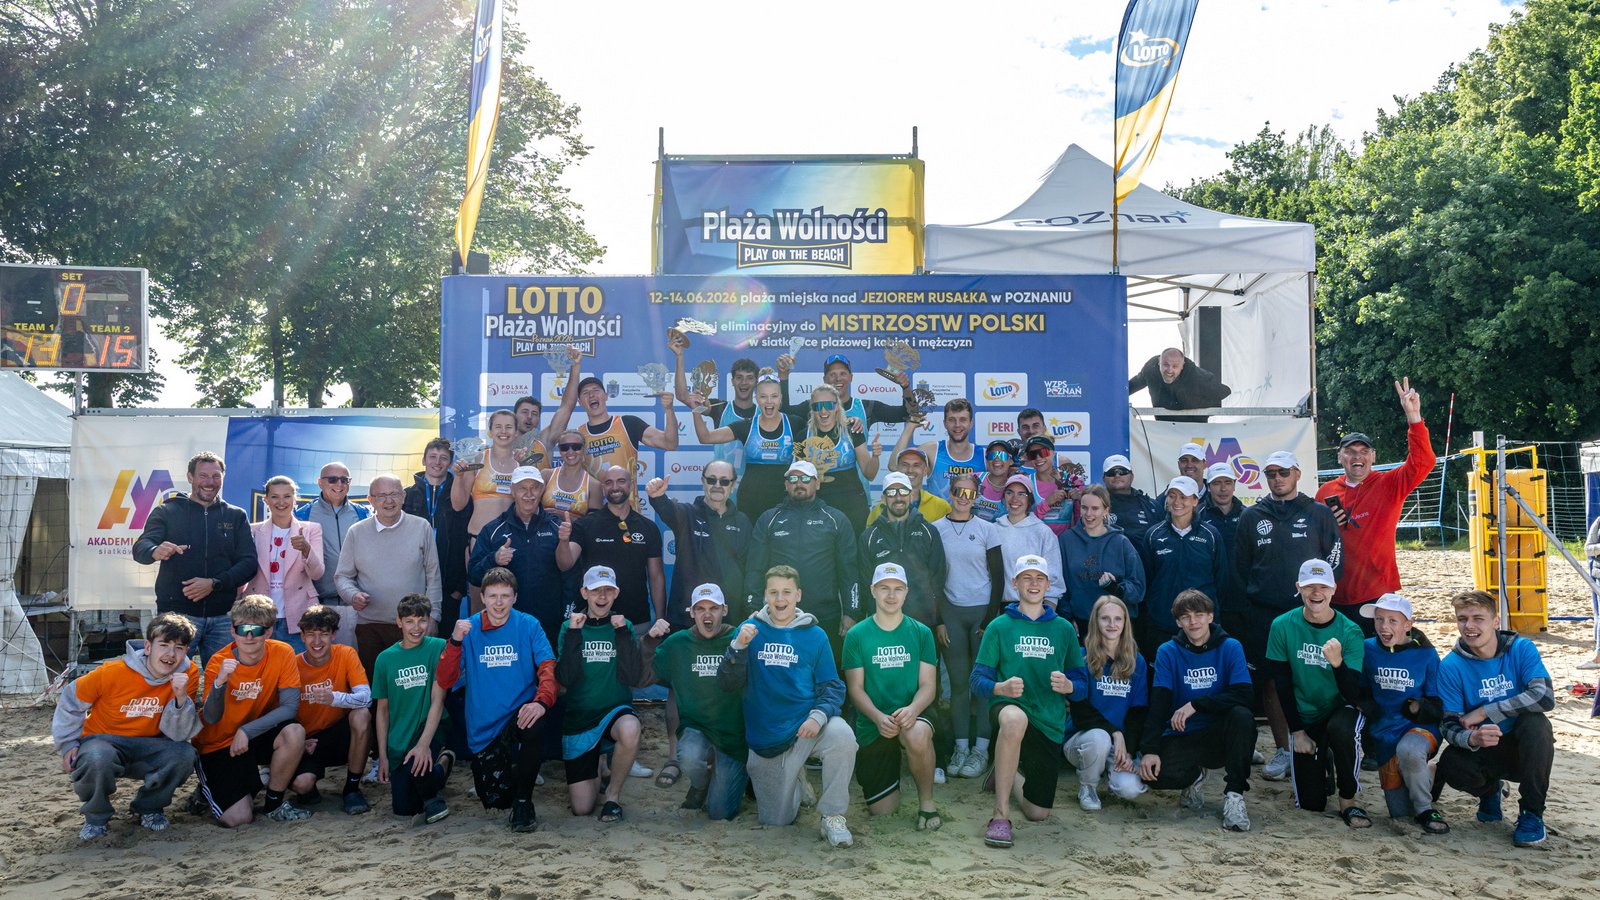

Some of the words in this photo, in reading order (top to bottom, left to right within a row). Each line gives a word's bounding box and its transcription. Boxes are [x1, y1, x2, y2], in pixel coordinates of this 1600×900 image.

[1133, 44, 1170, 61] LOTTO
[703, 209, 771, 240] Plaża
[776, 209, 885, 240] Wolności
[744, 248, 768, 261] PLAY
[772, 249, 785, 260] ON
[790, 249, 807, 260] THE
[811, 248, 844, 262] BEACH
[60, 283, 86, 315] 0
[507, 286, 603, 314] LOTTO
[649, 292, 737, 304] 12-14.06.2026
[740, 291, 776, 306] plaża
[779, 292, 828, 306] miejska
[832, 292, 857, 303] nad
[860, 292, 924, 303] JEZIOREM
[928, 292, 988, 303] RUSAŁKA
[990, 294, 1002, 303] w
[1005, 292, 1072, 303] POZNANIU
[14, 323, 45, 331] TEAM
[486, 315, 536, 337] Plaża
[540, 314, 621, 337] Wolności
[720, 321, 797, 333] eliminacyjny
[800, 321, 816, 331] do
[821, 314, 963, 331] MISTRZOSTW
[969, 314, 1045, 331] POLSKI
[90, 325, 120, 333] TEAM
[516, 342, 534, 352] PLAY
[749, 339, 759, 347] w
[761, 337, 818, 347] siatkce
[821, 337, 871, 349] plażowej
[912, 337, 916, 347] i
[918, 337, 972, 349] mężczyzn
[99, 335, 137, 367] 15
[1044, 380, 1068, 388] WZPS
[990, 385, 1013, 396] LOTTO
[1046, 385, 1082, 395] POZNAŃ
[991, 422, 1014, 432] PERI
[1052, 424, 1075, 436] LOTTO
[589, 436, 615, 448] LOTTO
[948, 466, 974, 475] LOTTO
[586, 642, 611, 650] LOTTO
[1020, 637, 1048, 646] LOTTO
[486, 646, 513, 655] LOTTO
[765, 644, 792, 655] LOTTO
[878, 646, 904, 656] LOTTO
[1015, 644, 1030, 653] Plaża
[1303, 644, 1323, 654] LOTT
[480, 655, 494, 663] Plaża
[495, 653, 518, 662] Wolności
[697, 656, 723, 665] LOTTO
[759, 652, 773, 661] Plaża
[774, 653, 798, 663] Wolności
[873, 655, 887, 663] Plaża
[888, 653, 910, 662] Wolności
[400, 666, 426, 678] LOTTO
[1188, 669, 1215, 679] LOTTO
[1378, 669, 1408, 679] LOTTO
